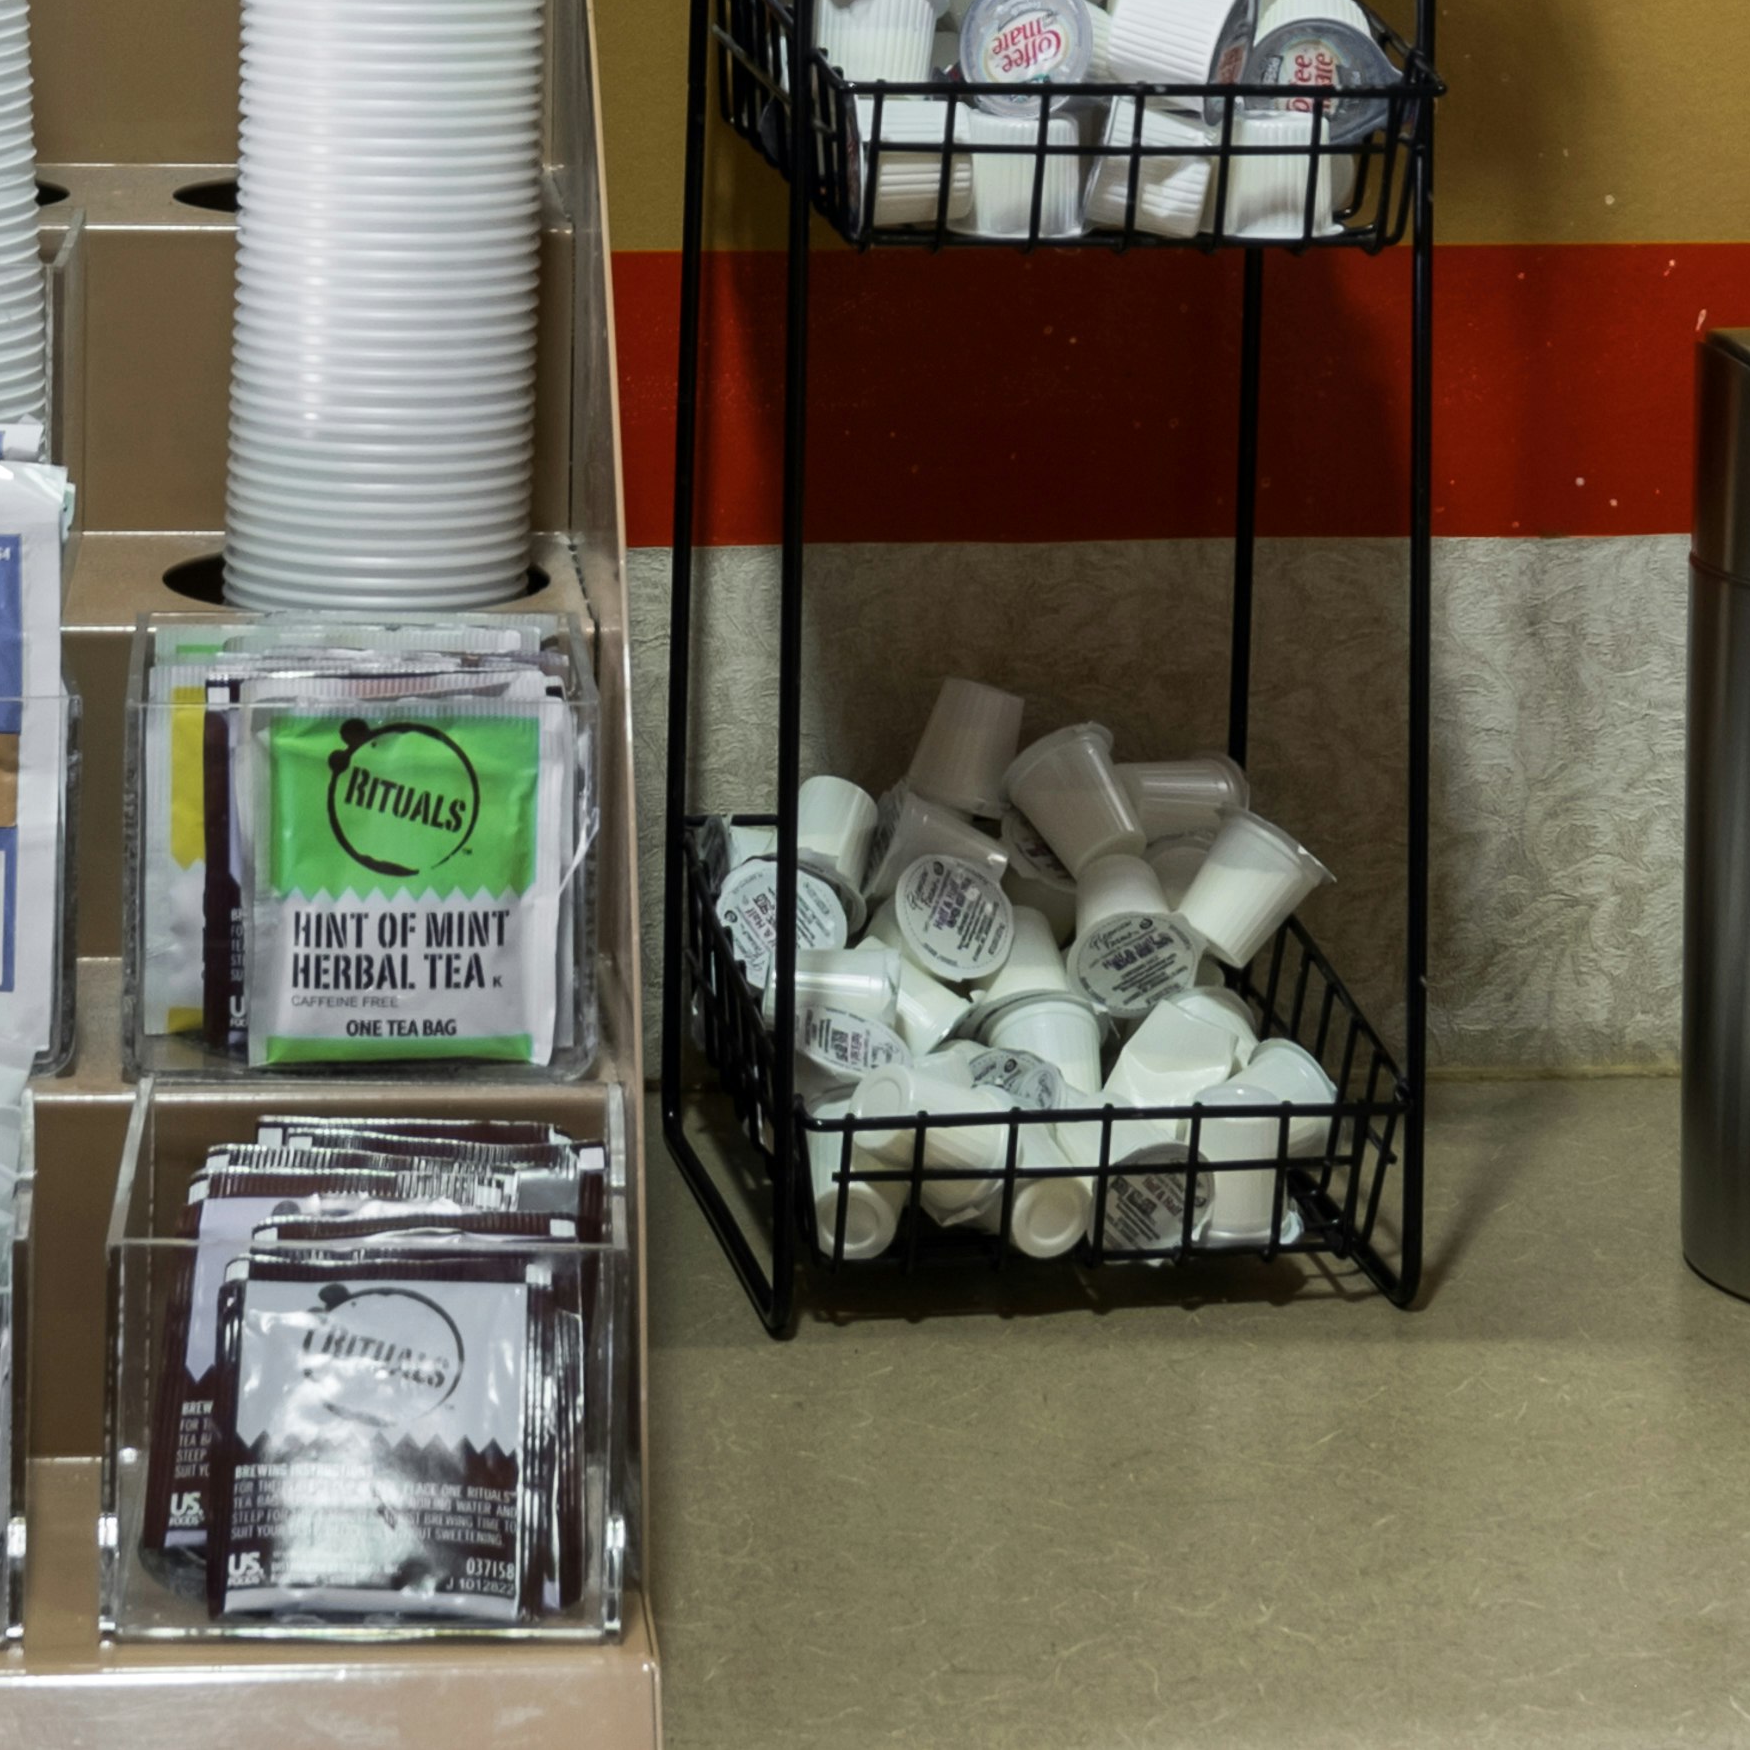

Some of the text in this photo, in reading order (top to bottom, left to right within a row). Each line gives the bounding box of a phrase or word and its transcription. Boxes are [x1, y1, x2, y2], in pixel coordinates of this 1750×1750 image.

[992, 18, 1043, 55] mate
[1002, 30, 1061, 73] Coffee
[344, 768, 467, 834] RITUALS
[294, 910, 510, 948] HINT OF MINT
[291, 953, 416, 990] HERBAL
[424, 953, 485, 990] TEA
[291, 995, 399, 1009] CAFFEINE FREE
[346, 1019, 457, 1037] ONE TEA BAG
[181, 1400, 213, 1416] BREW
[456, 1500, 491, 1514] WATER
[232, 1510, 264, 1525] STEEP
[424, 1513, 473, 1528] BREWING
[477, 1520, 499, 1531] TIME
[231, 1525, 252, 1540] SUIT
[465, 1557, 515, 1580] 037158
